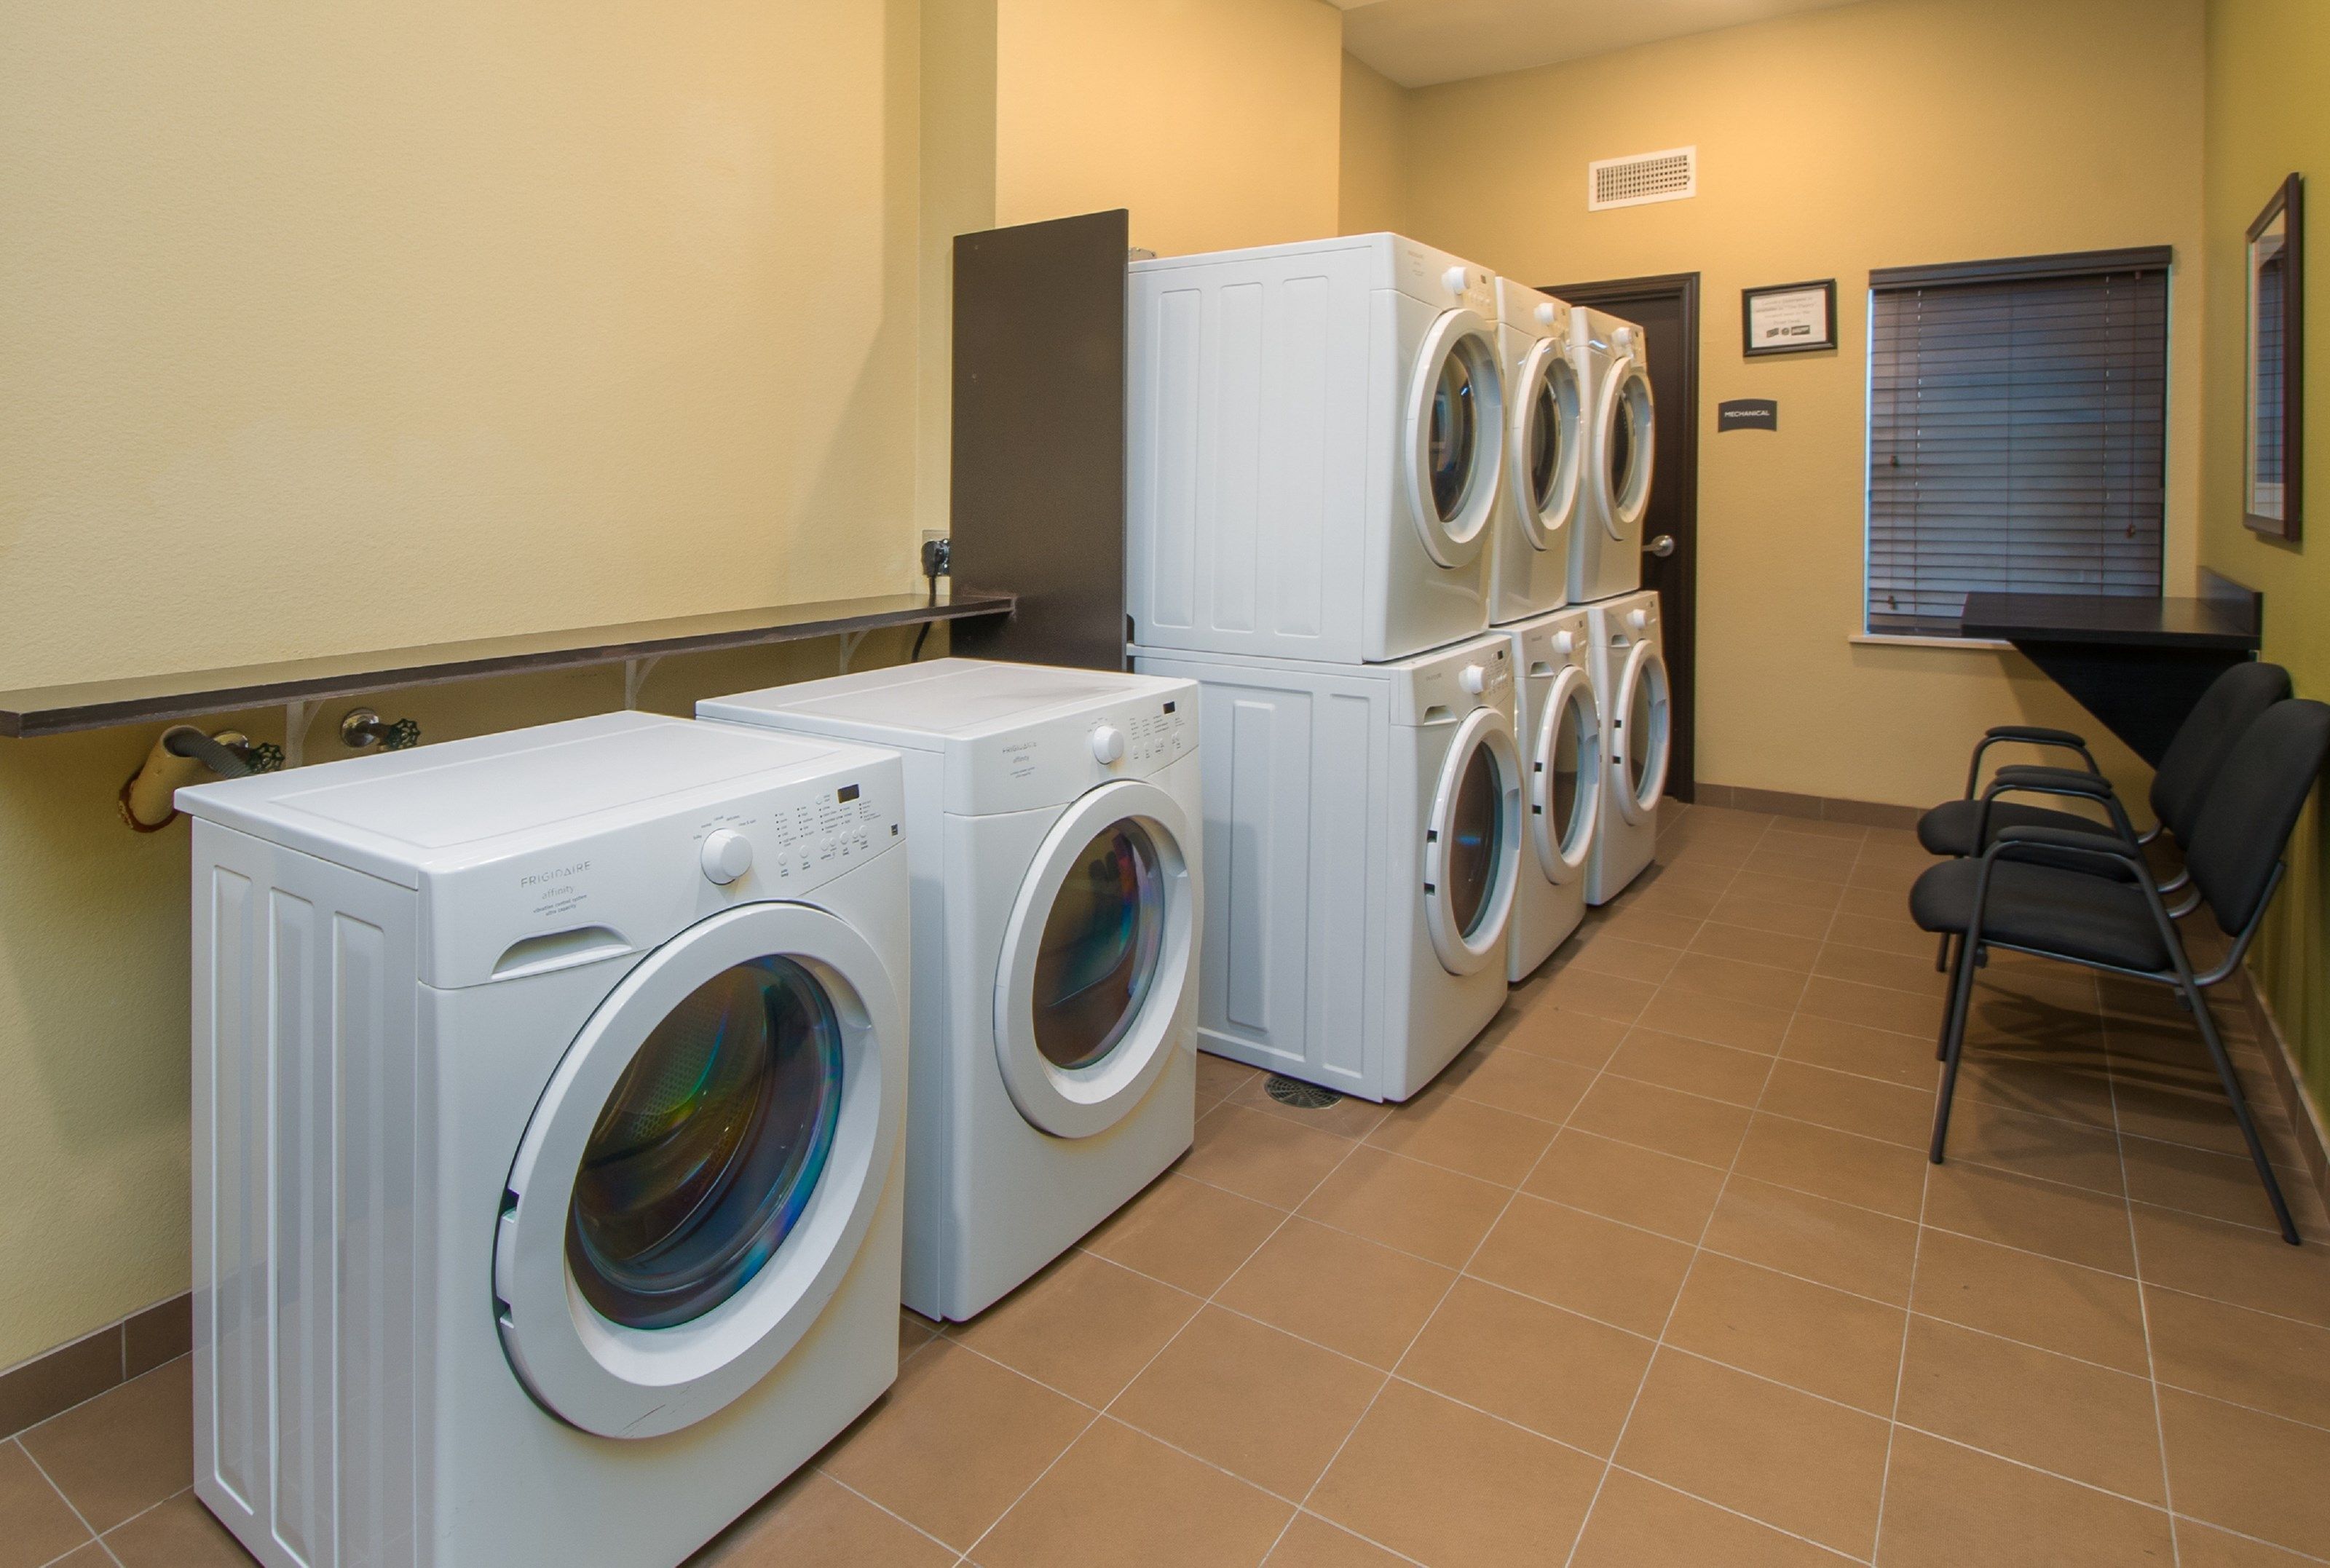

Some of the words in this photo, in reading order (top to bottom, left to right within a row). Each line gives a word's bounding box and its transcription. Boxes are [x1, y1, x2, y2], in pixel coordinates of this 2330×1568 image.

[1724, 410, 1771, 418] MECHANICAL
[520, 860, 591, 888] FRIGIDAIRE
[542, 885, 574, 900] affinity
